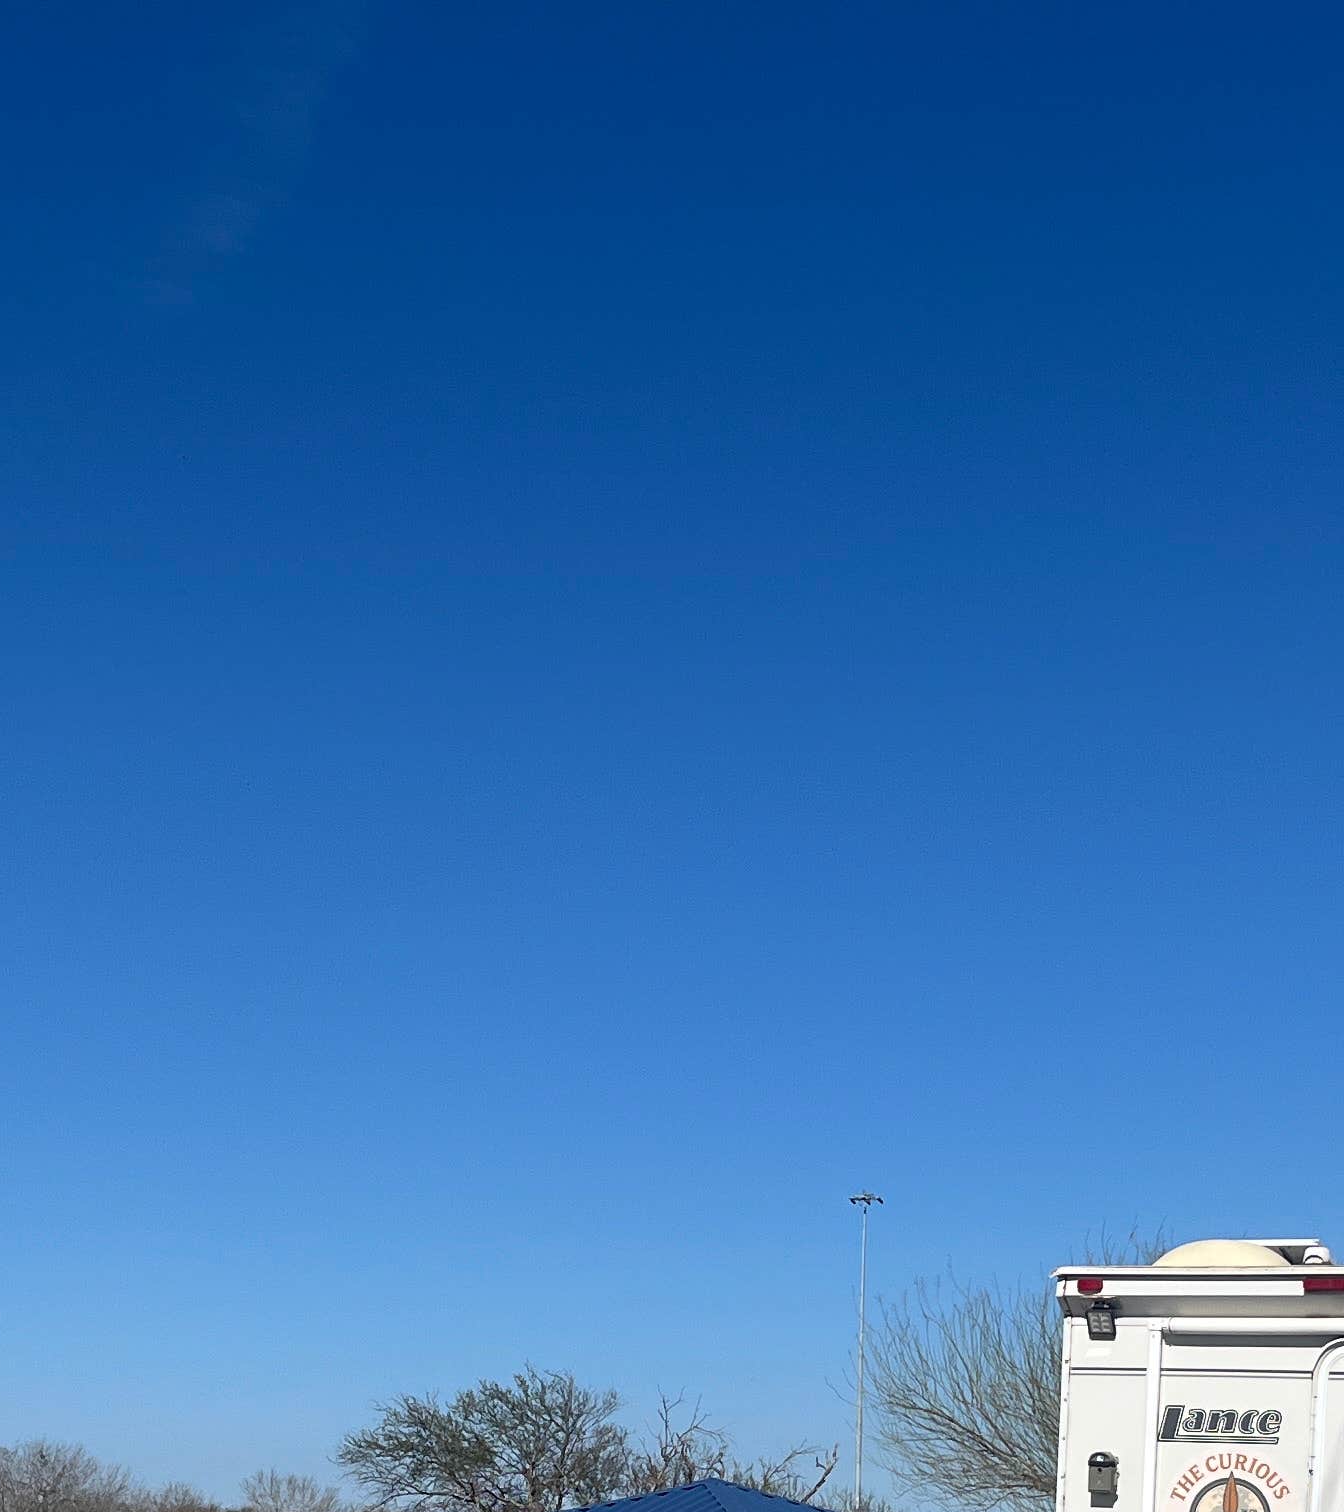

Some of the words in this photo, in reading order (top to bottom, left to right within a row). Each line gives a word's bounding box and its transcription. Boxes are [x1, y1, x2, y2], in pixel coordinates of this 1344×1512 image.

[1157, 1404, 1283, 1445] Lance
[1170, 1464, 1205, 1502] THE
[1206, 1453, 1290, 1500] CURIOUS
